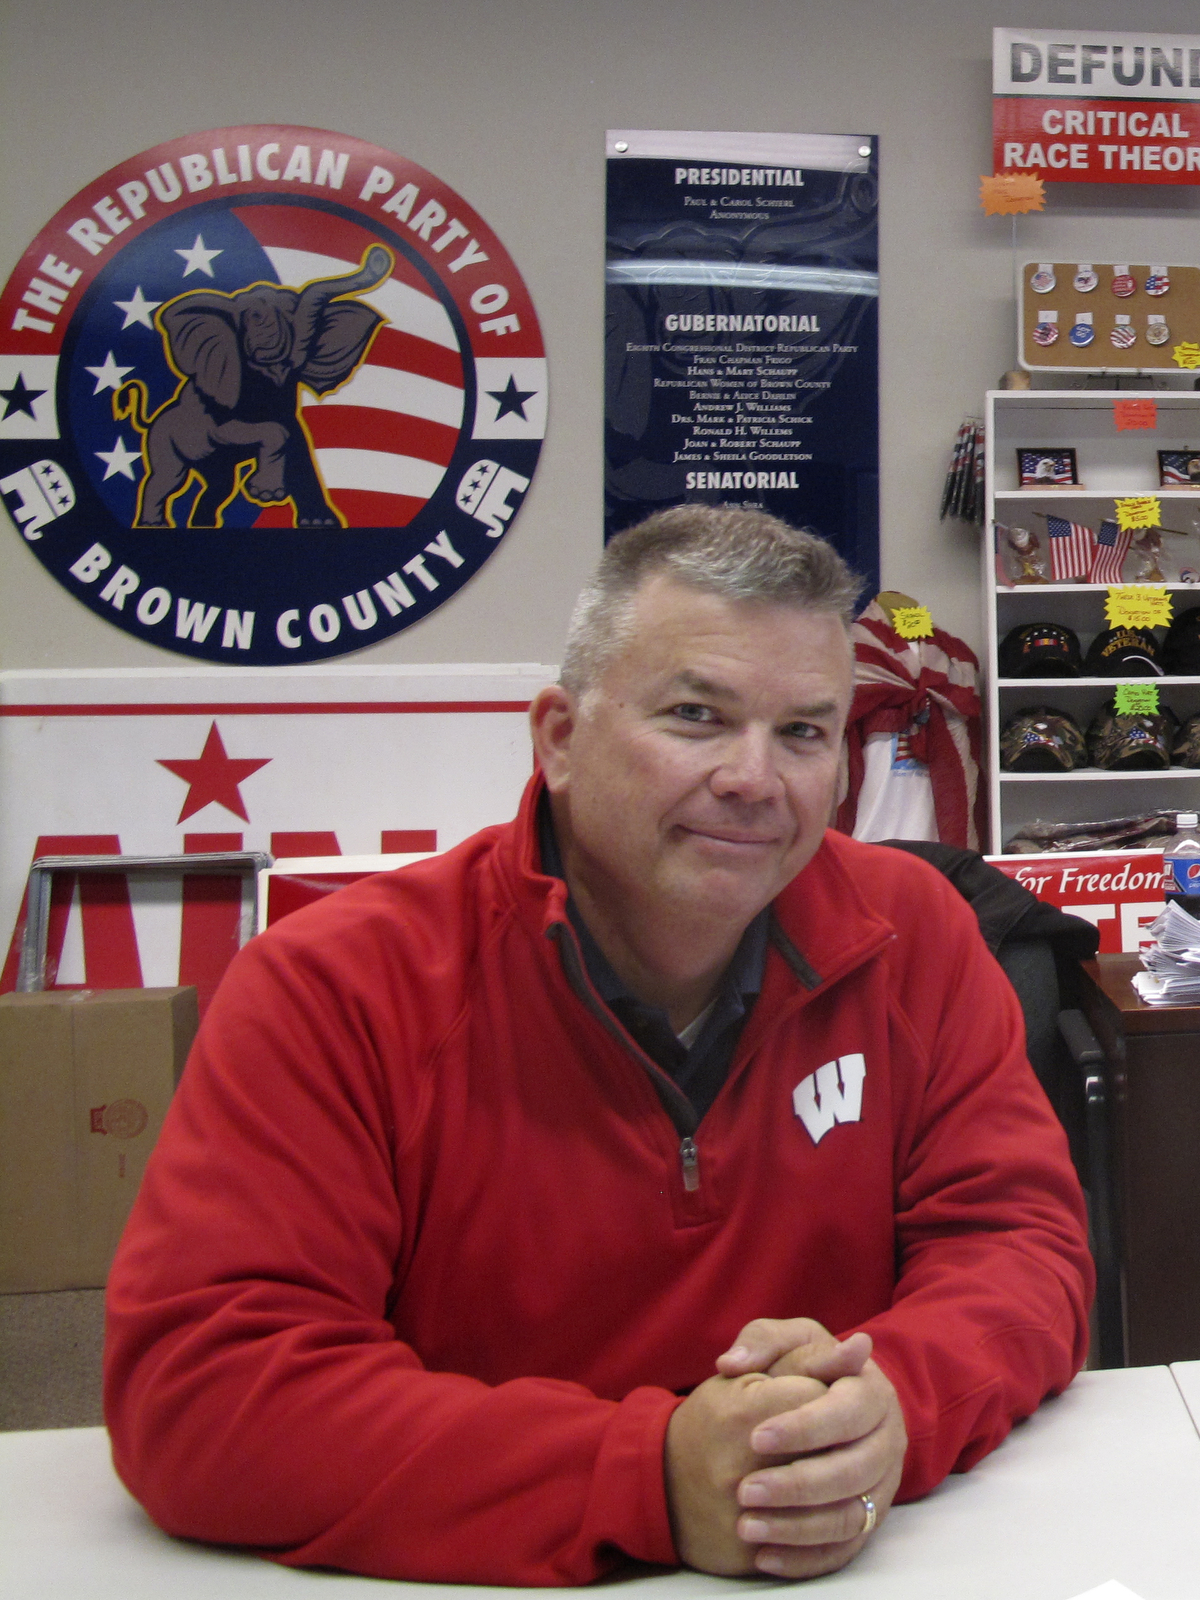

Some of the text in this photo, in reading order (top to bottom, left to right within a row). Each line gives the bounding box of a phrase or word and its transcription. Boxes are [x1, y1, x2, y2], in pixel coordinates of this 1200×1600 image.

[1042, 109, 1190, 138] CRITICAL
[1003, 142, 1090, 169] RACE
[674, 167, 805, 187] PRESIDENTIAL
[710, 199, 717, 207] &
[709, 209, 770, 220] ANONYMOUS
[13, 142, 521, 339] THE REPUBLICAN PARTY OF
[665, 314, 821, 332] GUBERNATORIAL
[626, 342, 660, 352] EIGHTH
[662, 342, 734, 353] CONGRESSIONAL
[777, 343, 830, 353] REPUBLICAN
[832, 343, 859, 353] PARTY
[654, 378, 708, 388] REPUBLICAN
[709, 379, 745, 388] WOMEN
[760, 379, 793, 388] BROWN
[794, 379, 832, 389] COUNTY
[693, 402, 734, 412] ANDREW
[746, 402, 792, 412] WILLIAMS
[696, 414, 726, 424] MARK
[736, 414, 776, 424] PATRICIA
[693, 426, 732, 436] RONALD
[735, 426, 748, 436] H.
[683, 439, 708, 450] JOAN
[719, 439, 757, 448] ROBERT
[673, 451, 702, 463] JAMES
[686, 471, 800, 490] SENATORIAL
[68, 529, 467, 651] BROWN COUNTY
[1059, 862, 1165, 894] Freedom
[792, 1052, 867, 1147] W
